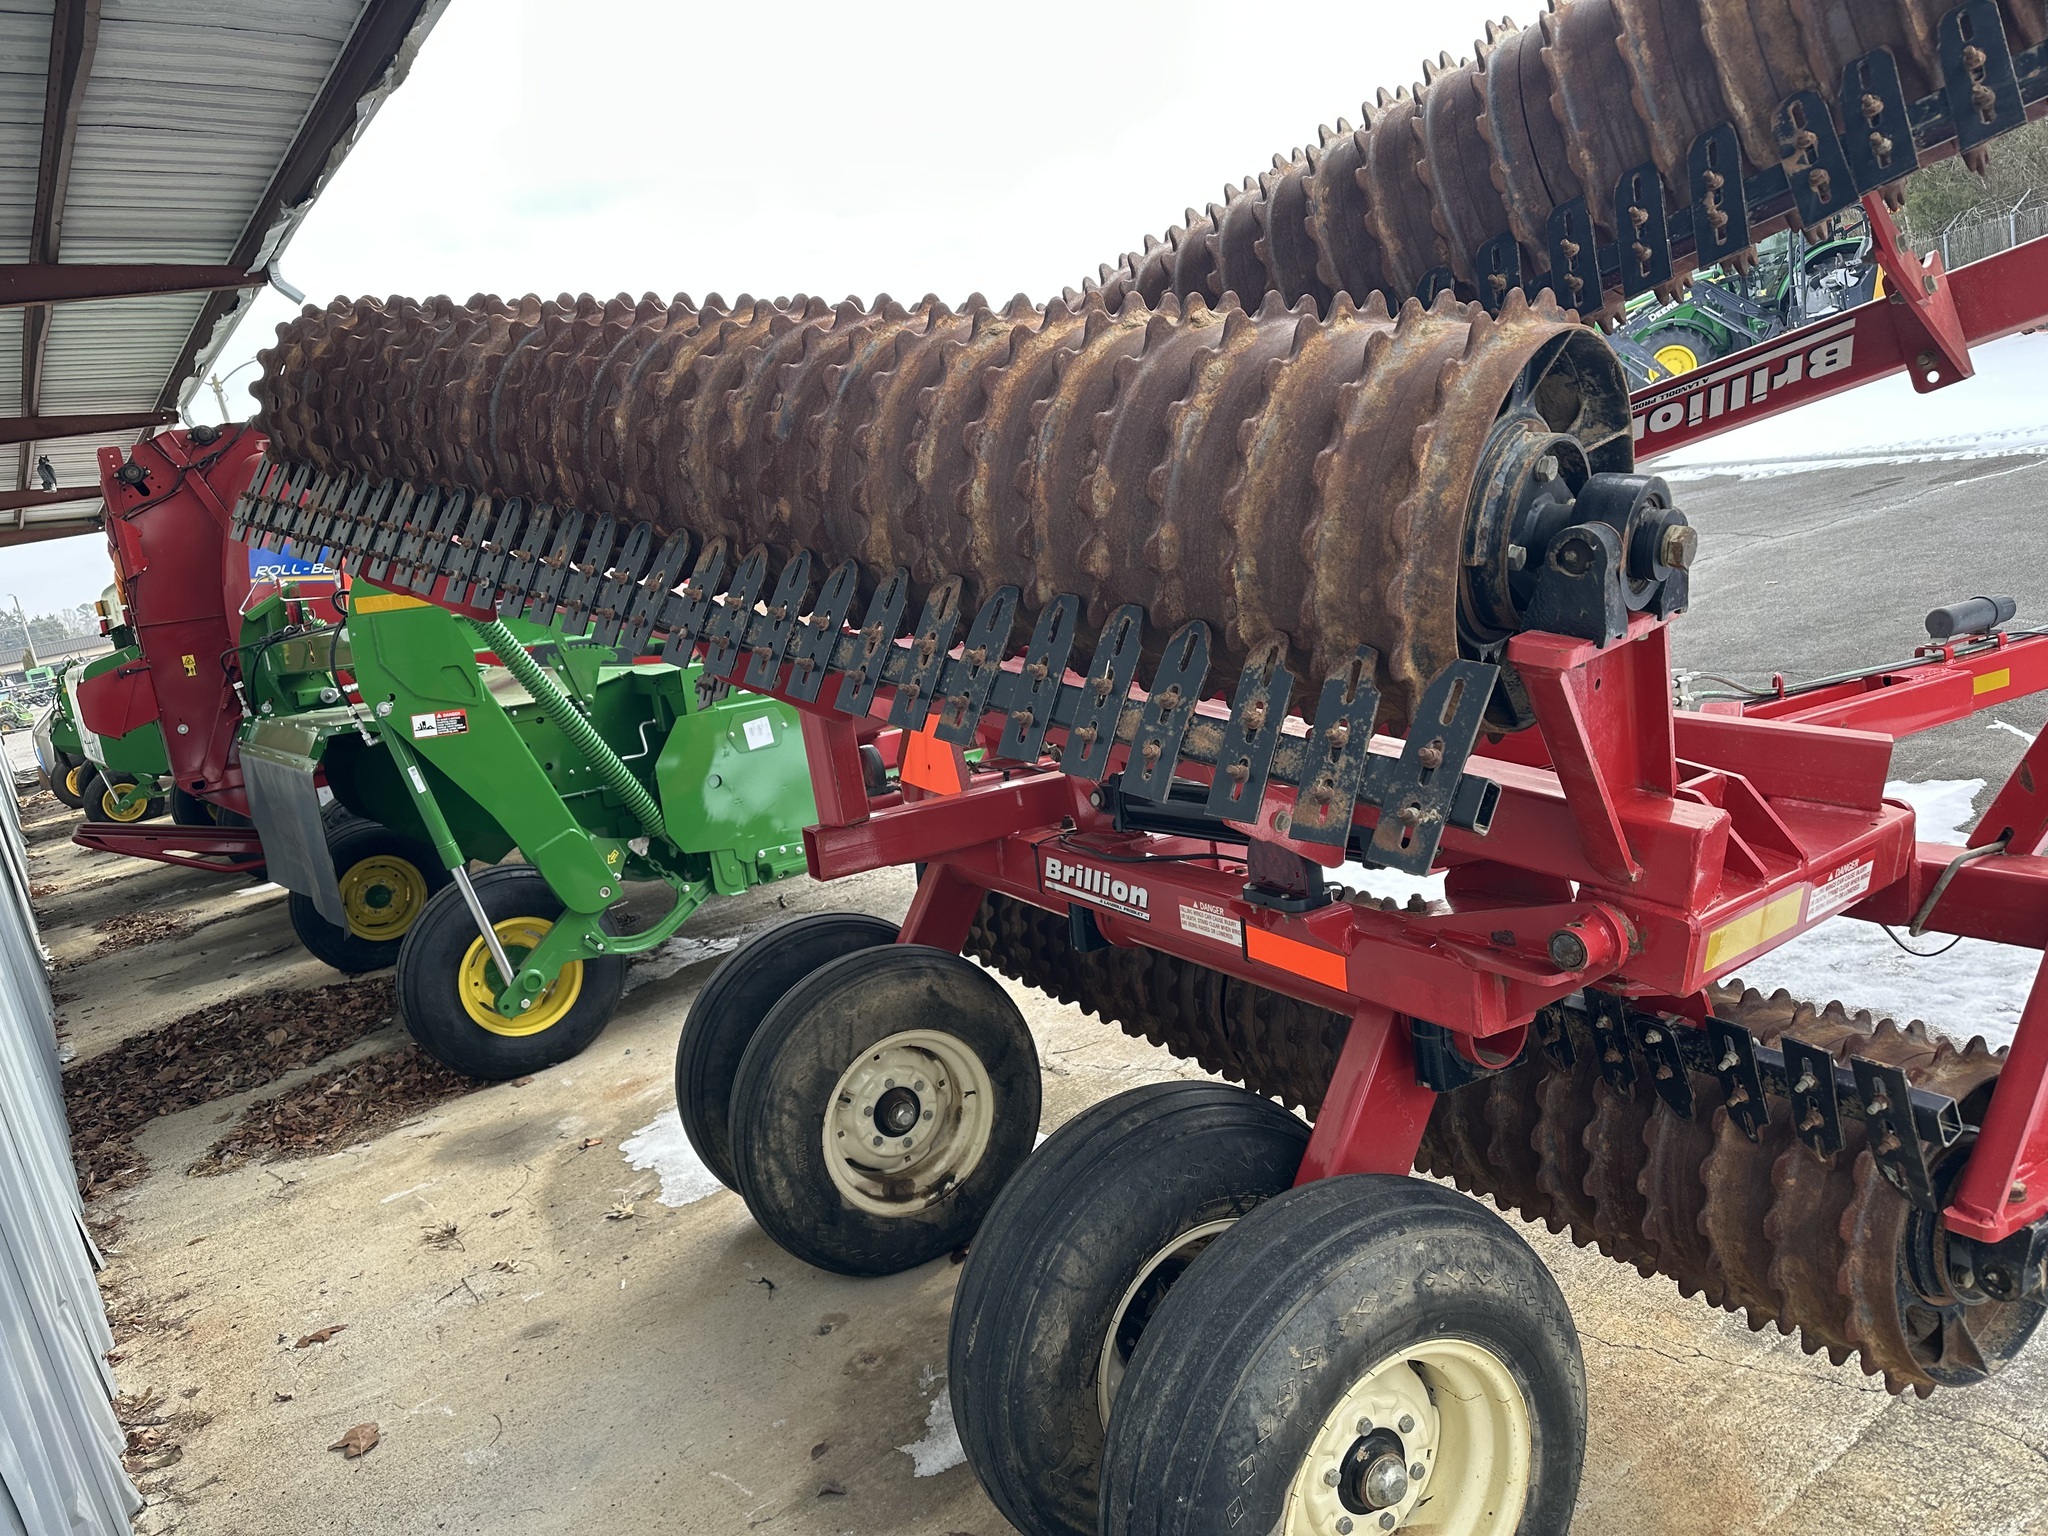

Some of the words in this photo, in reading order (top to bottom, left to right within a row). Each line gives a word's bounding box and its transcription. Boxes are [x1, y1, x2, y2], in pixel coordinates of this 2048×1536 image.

[1660, 381, 1700, 400] LANDOLL
[1632, 398, 1657, 411] PROD
[255, 563, 334, 577] ROLL-BE
[1835, 858, 1860, 878] DANGER
[1045, 856, 1148, 909] Brillion
[1199, 901, 1225, 917] DANGER
